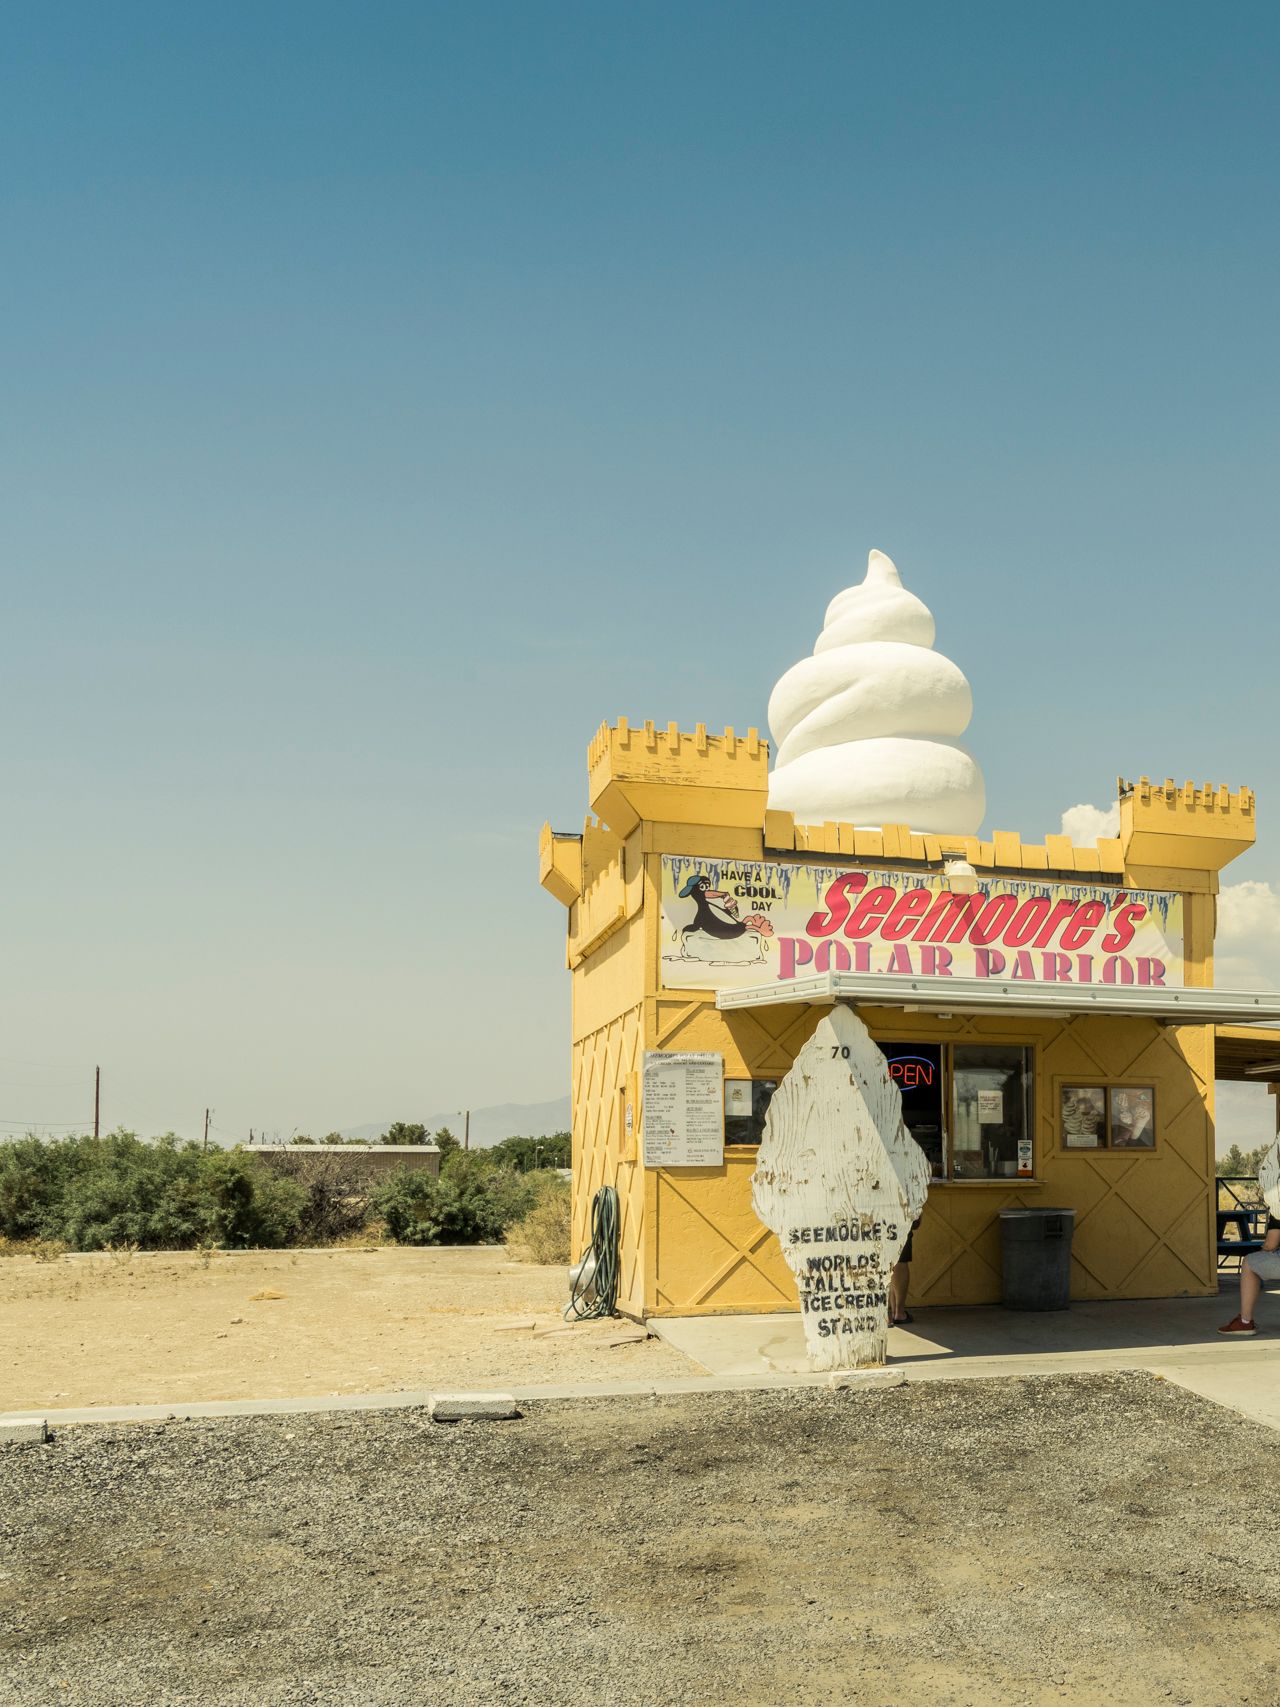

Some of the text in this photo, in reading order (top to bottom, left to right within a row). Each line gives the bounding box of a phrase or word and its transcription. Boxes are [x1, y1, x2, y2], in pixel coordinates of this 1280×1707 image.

[721, 870, 762, 883] HAVE A
[734, 884, 783, 899] COOL
[751, 900, 773, 911] DAY
[806, 872, 1147, 953] Seemoore's
[777, 937, 1166, 986] POLAR PARLOR
[831, 1046, 850, 1059] 70
[887, 1063, 932, 1085] PEN
[806, 1252, 880, 1272] WORLDS
[802, 1292, 887, 1314] ICE CREAM
[817, 1315, 878, 1337] STAND
